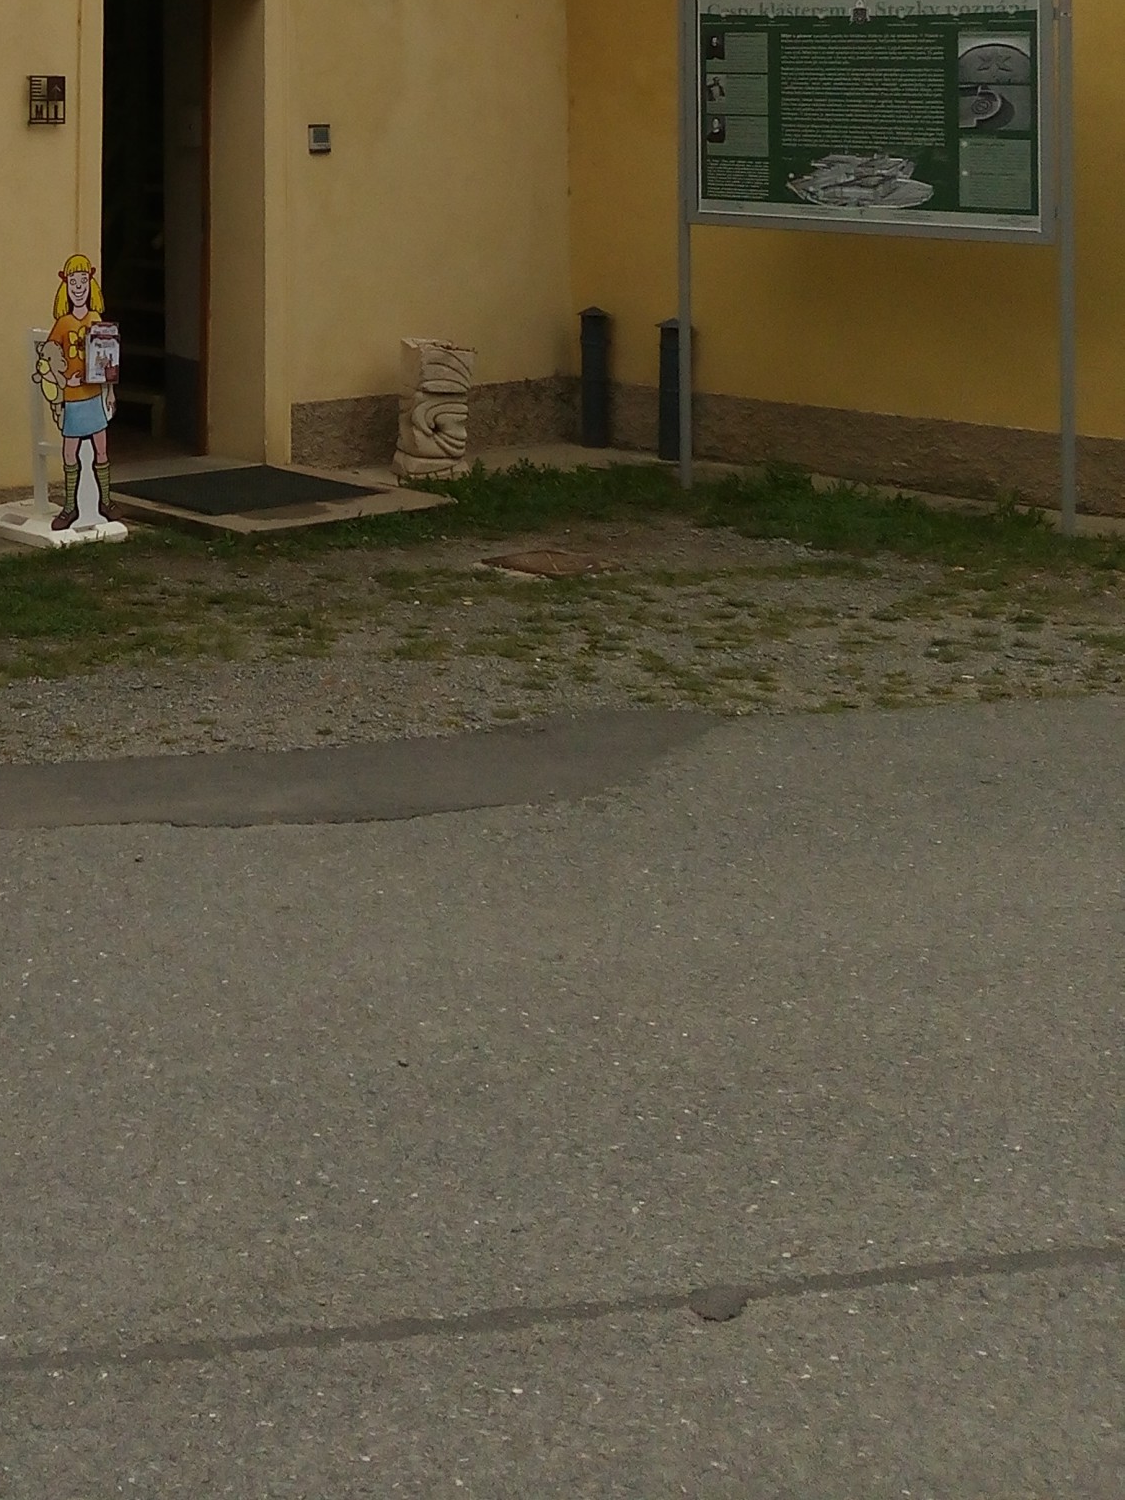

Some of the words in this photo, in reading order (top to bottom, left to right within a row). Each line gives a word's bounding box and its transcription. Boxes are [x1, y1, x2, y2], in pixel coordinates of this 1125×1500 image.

[707, 2, 754, 15] Cesty
[759, 1, 846, 16] klášterem
[875, 0, 939, 15] Stezky
[945, 0, 1028, 14] poznání
